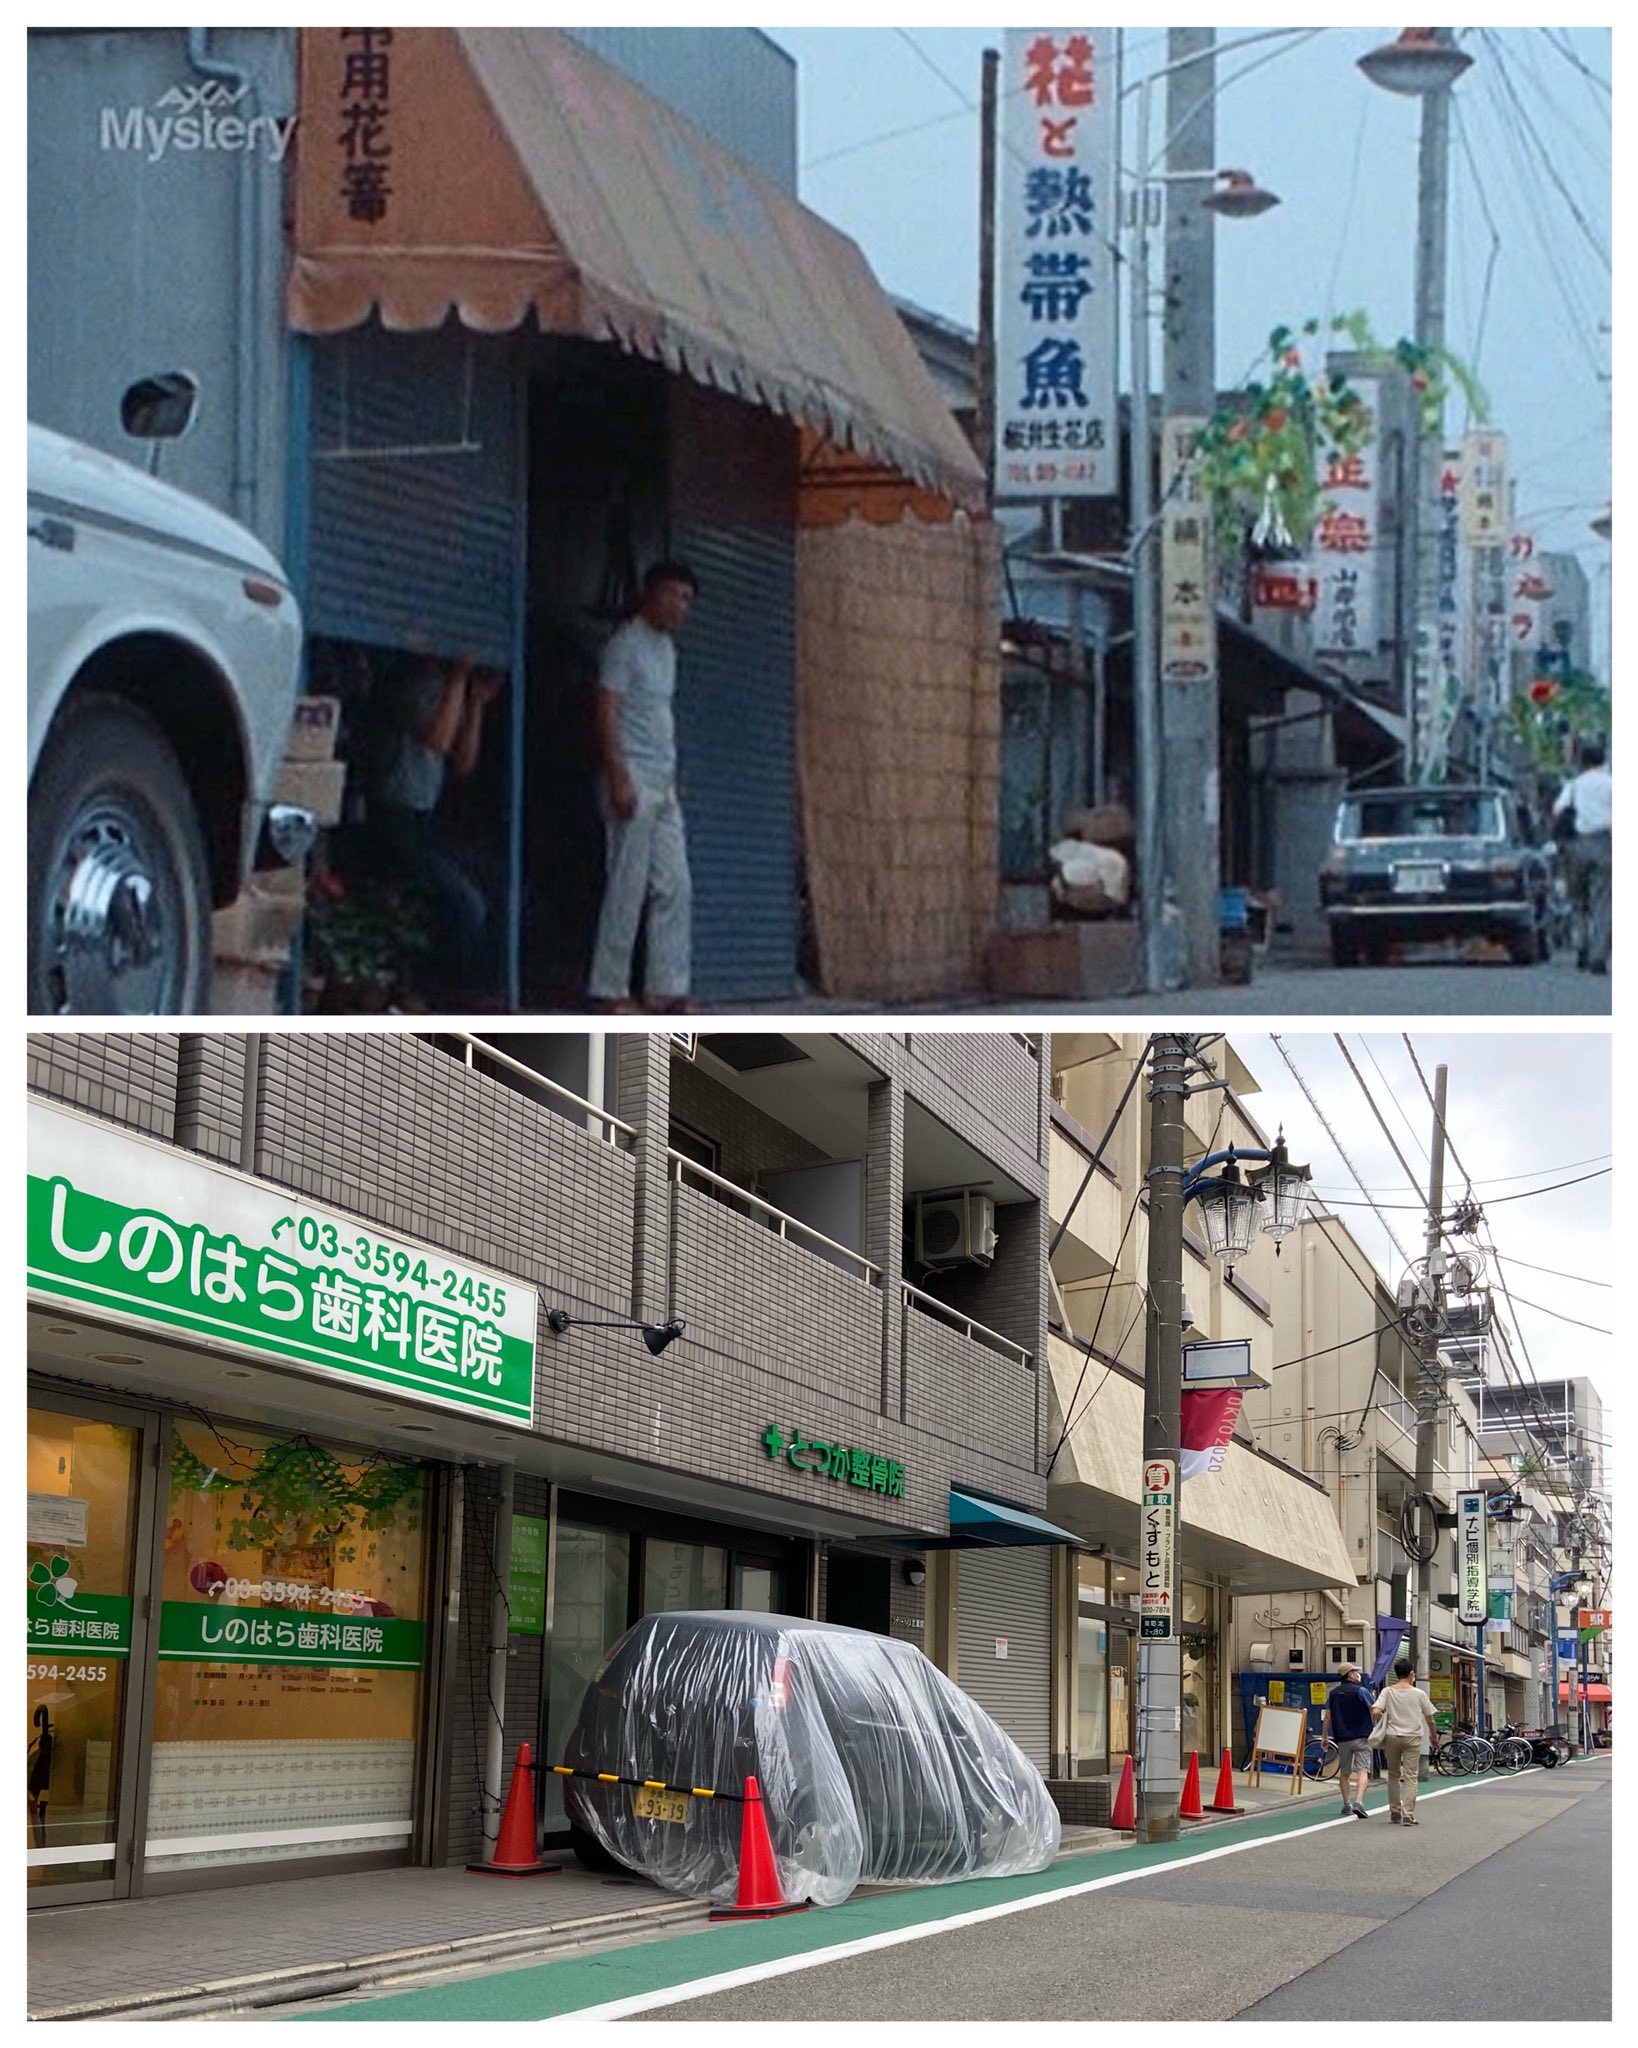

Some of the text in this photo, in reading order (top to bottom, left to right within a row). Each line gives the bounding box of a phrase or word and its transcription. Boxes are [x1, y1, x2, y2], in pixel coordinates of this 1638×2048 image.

[51, 1184, 503, 1386] しのはら歯科医院
[300, 1216, 507, 1319] 03-3594-2455
[787, 1429, 906, 1499] とつか整骨院
[1208, 1437, 1230, 1472] 2020
[1146, 1508, 1162, 1588] くすもと
[1465, 1516, 1480, 1611] ナビ個別指導学院
[201, 1615, 384, 1653] しのはら歯科医院
